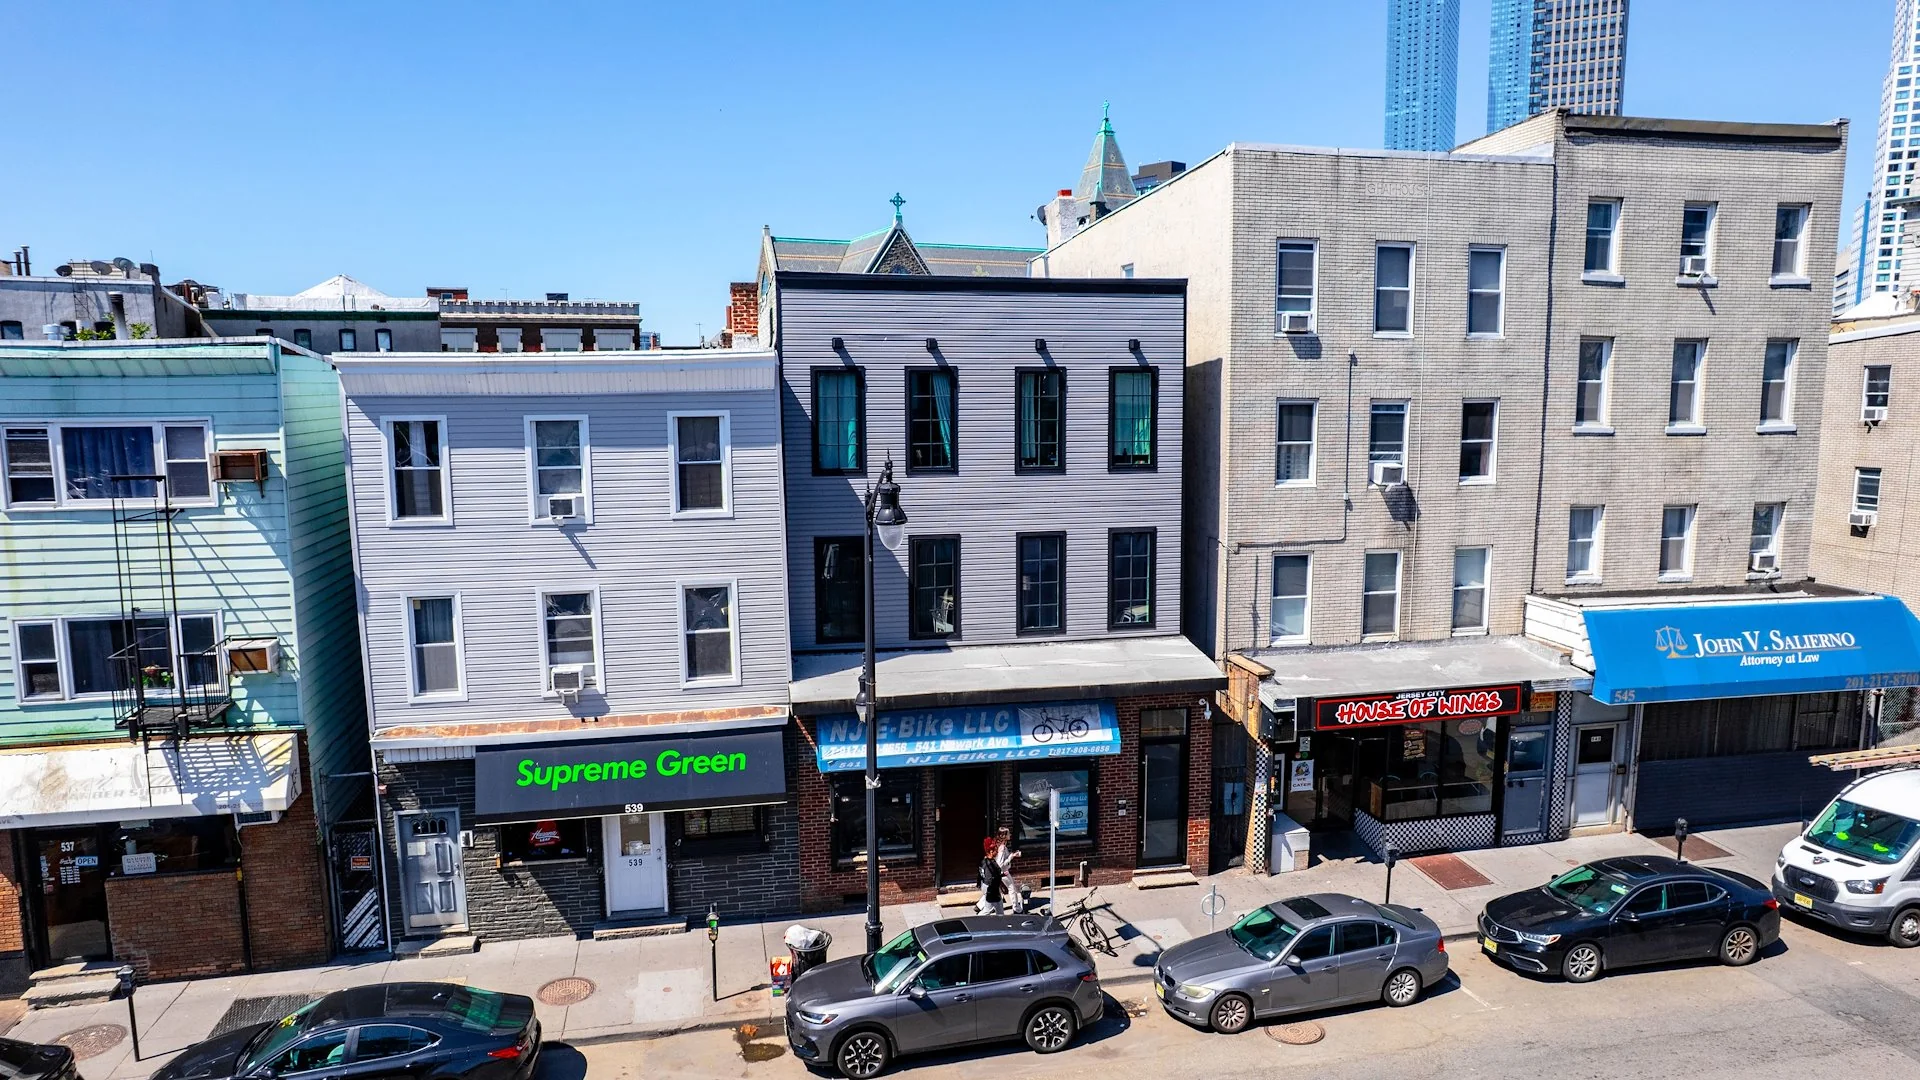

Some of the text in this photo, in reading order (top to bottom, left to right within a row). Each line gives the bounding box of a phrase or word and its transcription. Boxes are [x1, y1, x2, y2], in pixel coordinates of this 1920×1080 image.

[1771, 629, 1855, 650] SALIERNO
[1740, 652, 1819, 668] Attorney at Law
[1396, 689, 1446, 700] JERSEY CITY
[1614, 690, 1635, 702] 545
[1337, 691, 1502, 724] HOUSE OF WINGS
[963, 710, 1009, 735] LLC
[906, 755, 931, 764] NJ
[1005, 749, 1041, 758] LLC
[516, 749, 747, 791] Supreme Green
[624, 803, 644, 813] 539
[61, 841, 75, 852] 537
[77, 857, 96, 865] OPEN
[628, 858, 643, 867] 539
